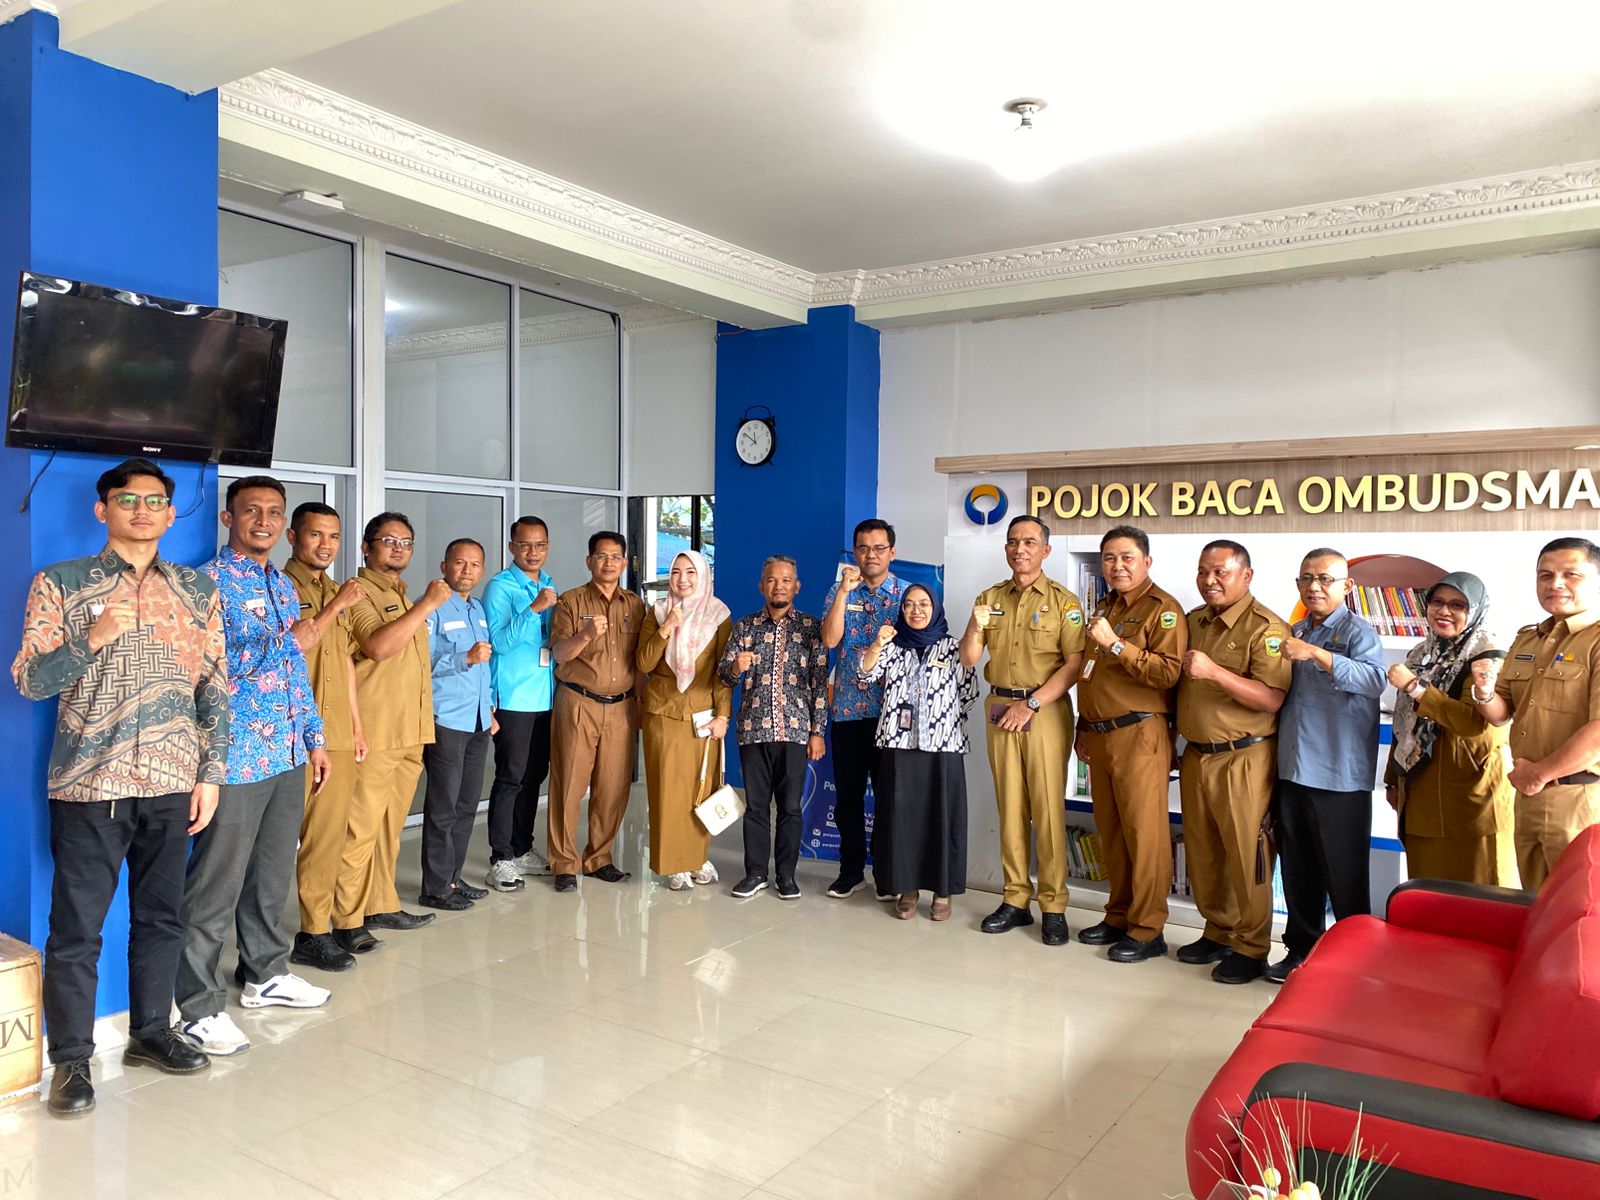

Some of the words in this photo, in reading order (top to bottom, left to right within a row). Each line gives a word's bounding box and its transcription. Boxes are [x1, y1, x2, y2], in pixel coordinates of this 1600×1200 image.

[1031, 483, 1159, 519] POJOK
[1172, 478, 1285, 516] BACA
[1298, 467, 1600, 514] OMBUDSMA
[823, 780, 836, 791] Pe
